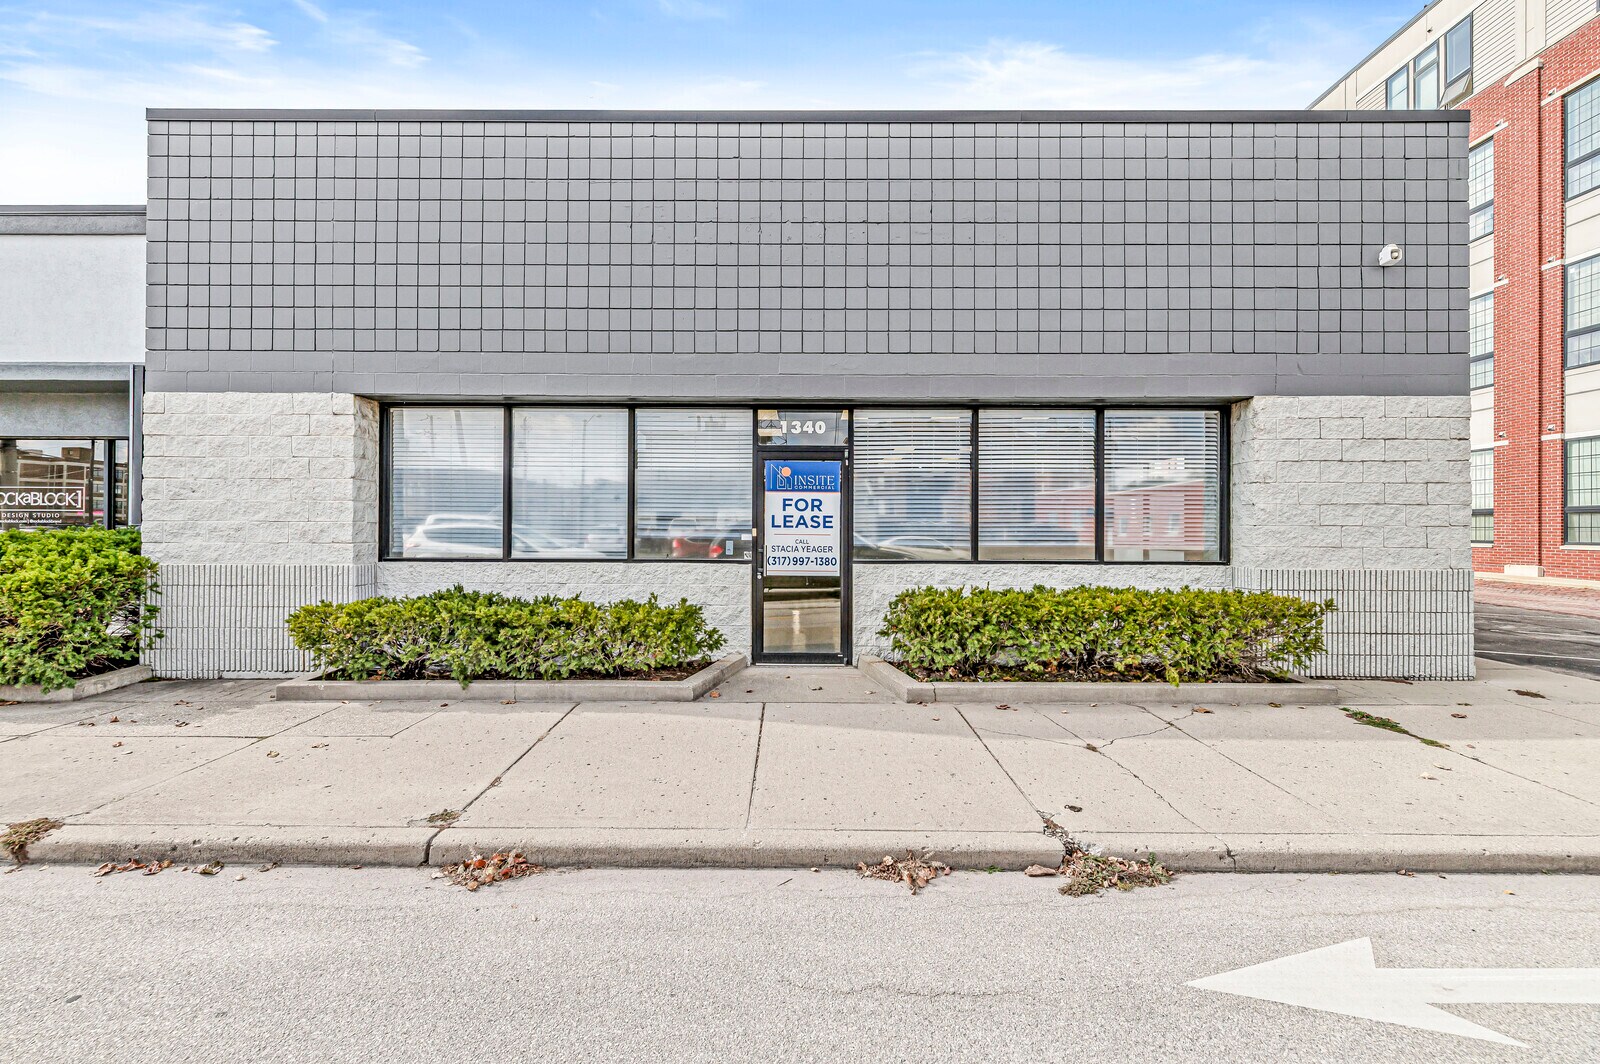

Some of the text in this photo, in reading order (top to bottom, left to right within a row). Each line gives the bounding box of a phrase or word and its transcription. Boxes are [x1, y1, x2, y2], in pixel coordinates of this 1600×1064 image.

[780, 420, 826, 434] 1340
[794, 475, 835, 486] INSITE
[782, 498, 823, 512] FOR
[771, 515, 834, 529] LEASE
[771, 545, 834, 553] STACIA YEAGER
[767, 556, 837, 566] (317) 997-1380
